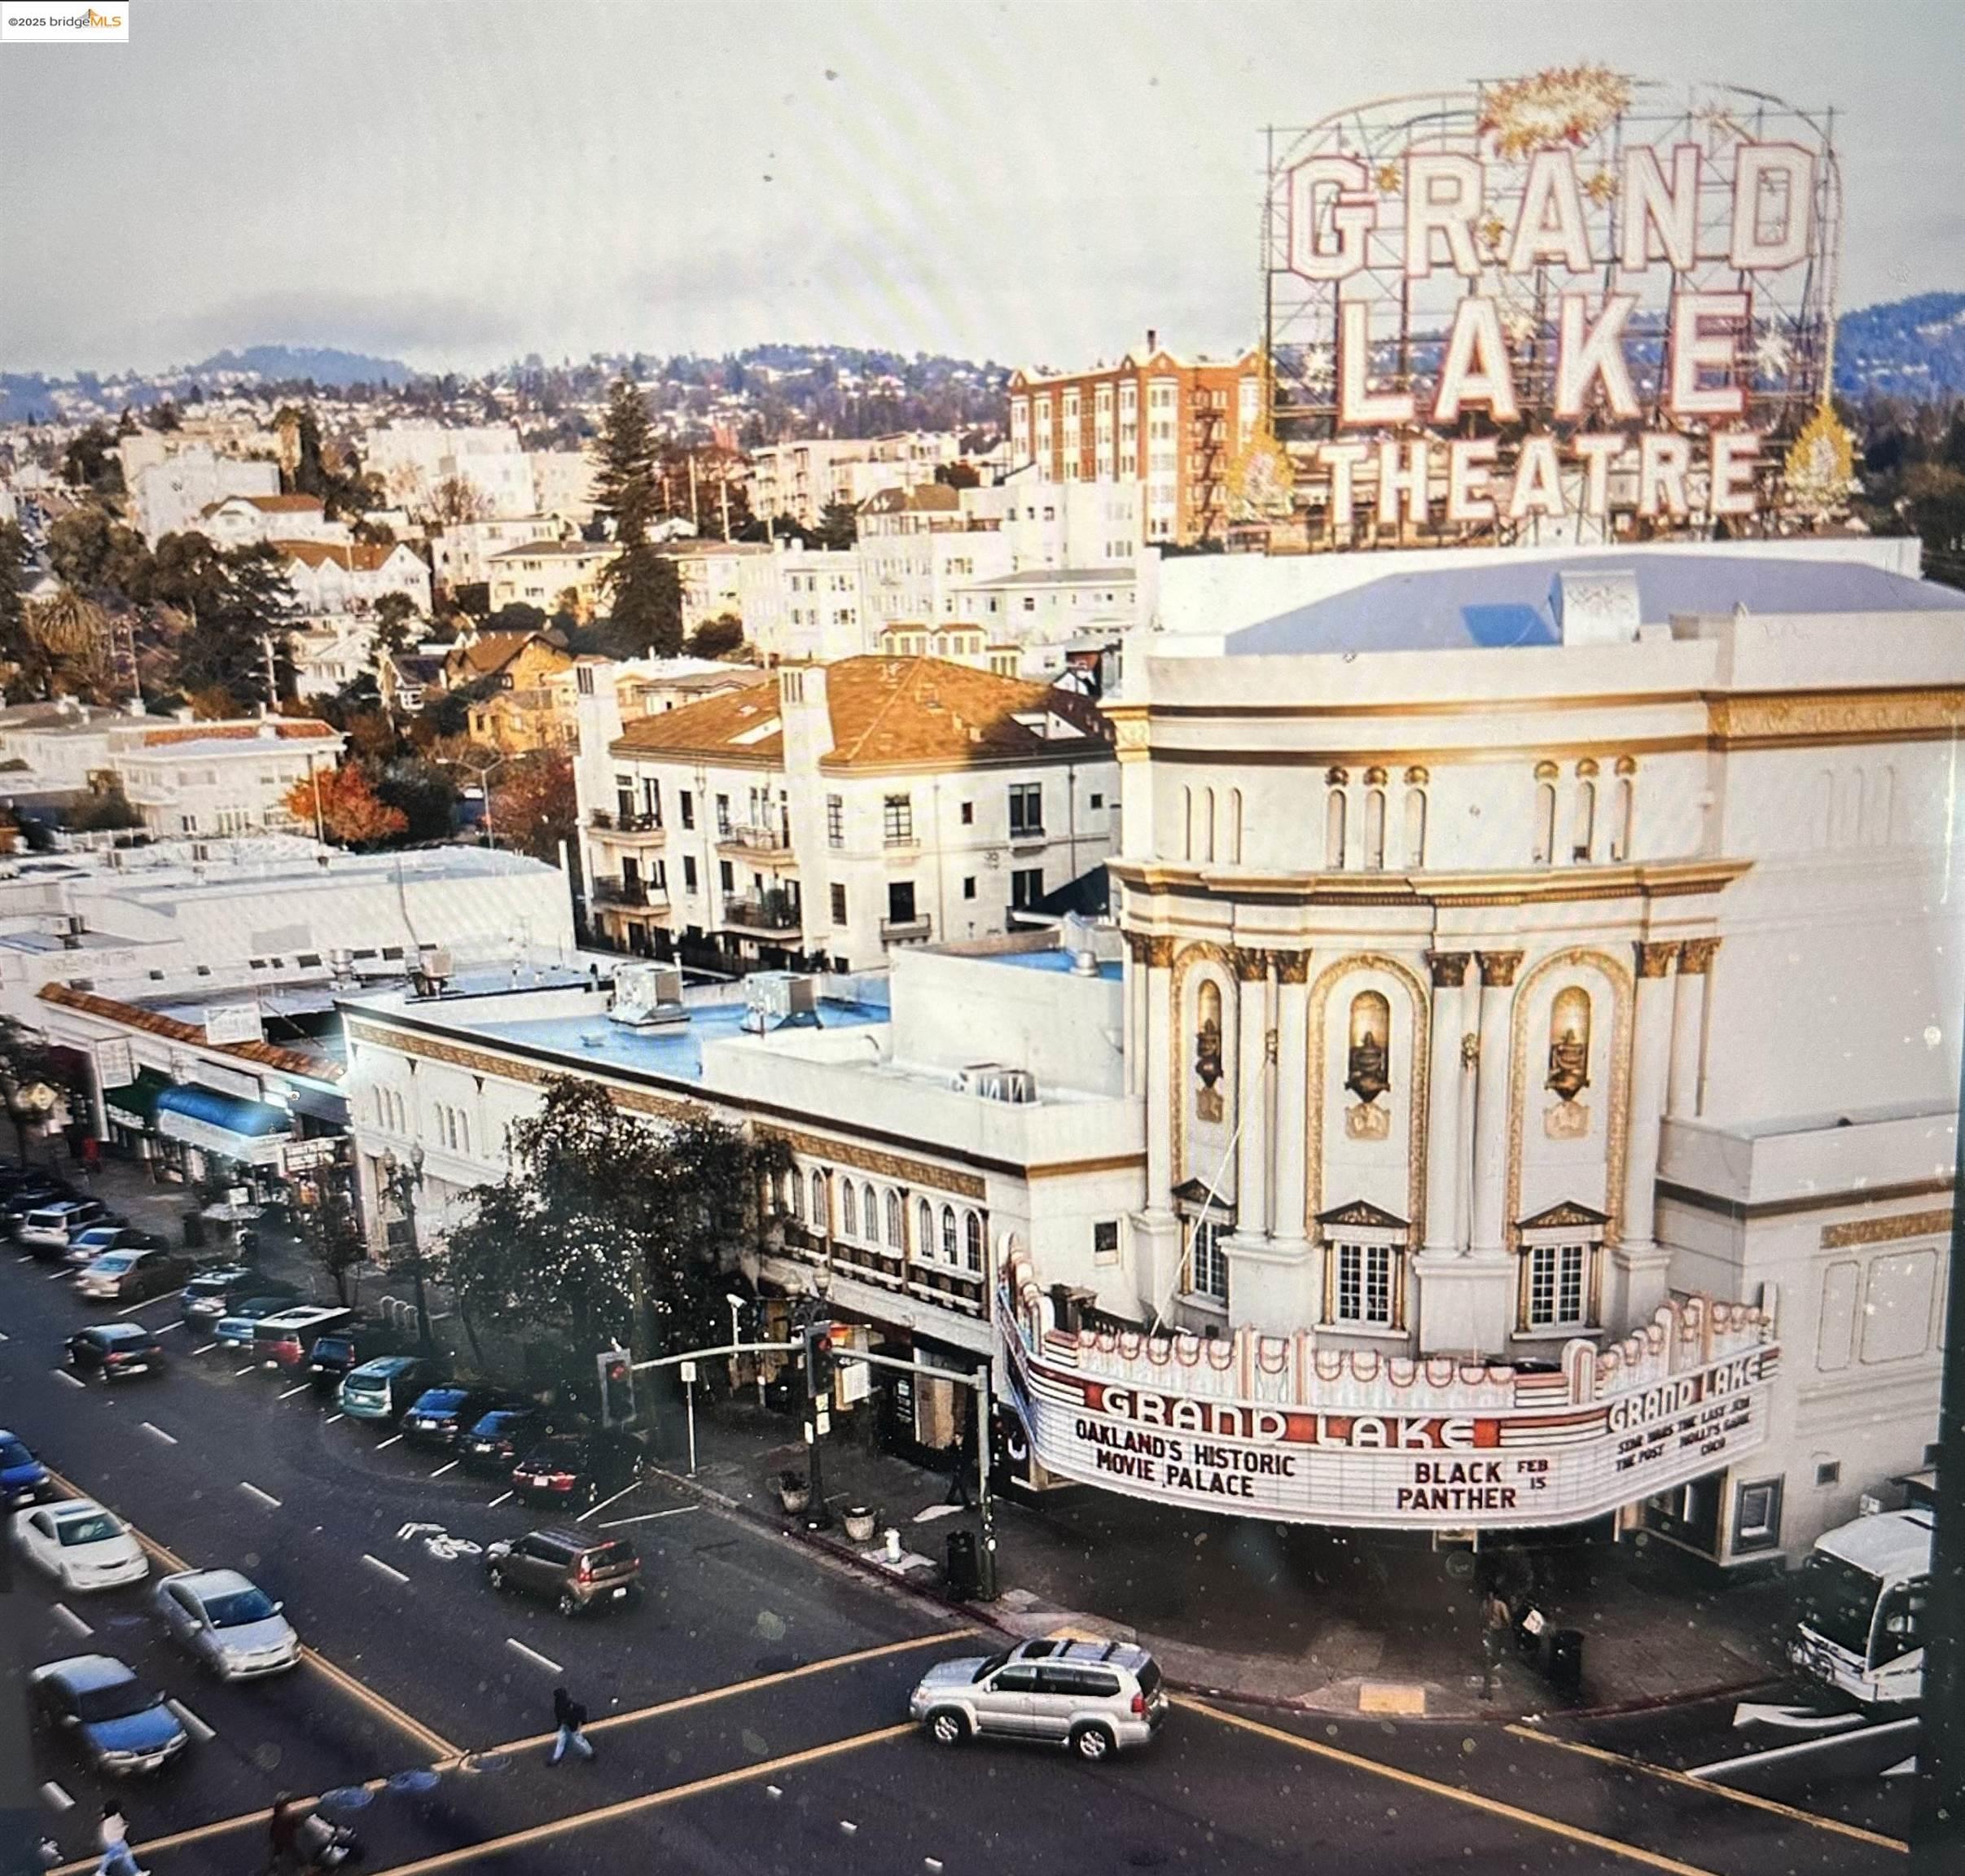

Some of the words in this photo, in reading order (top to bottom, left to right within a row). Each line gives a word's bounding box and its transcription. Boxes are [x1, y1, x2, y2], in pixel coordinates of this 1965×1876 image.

[1289, 140, 1817, 281] GRAND
[1338, 290, 1752, 428] LAKE
[1318, 428, 1761, 525] THEATRE
[1101, 1386, 1287, 1440] GRAND
[1317, 1414, 1474, 1449] LAKE
[1609, 1378, 1694, 1432] GRAND
[1701, 1354, 1761, 1399] LAKE
[1076, 1419, 1182, 1462] OAKLAND'S
[1195, 1443, 1296, 1476] HISTORIC
[1097, 1448, 1156, 1481] MOVIE
[1167, 1464, 1255, 1497] PALACE
[1415, 1462, 1502, 1484] BLACK
[1517, 1459, 1548, 1473] FEB
[1638, 1443, 1665, 1462] POST
[1397, 1488, 1516, 1510] PANTHER
[1529, 1476, 1546, 1489] 15
